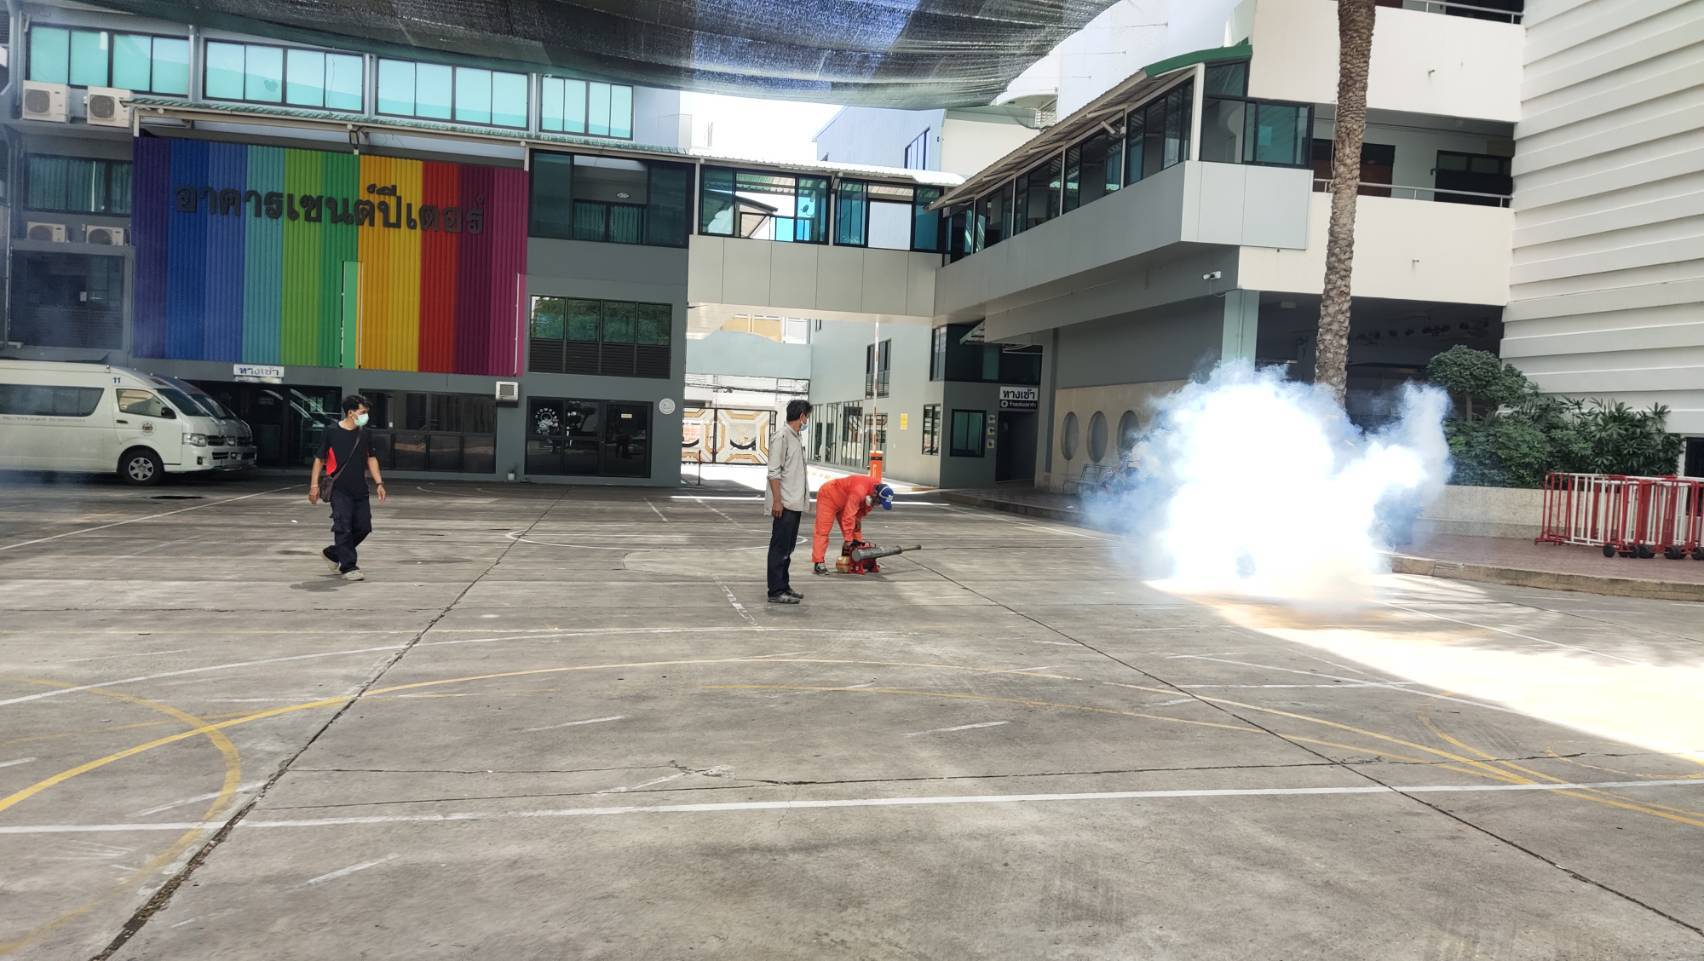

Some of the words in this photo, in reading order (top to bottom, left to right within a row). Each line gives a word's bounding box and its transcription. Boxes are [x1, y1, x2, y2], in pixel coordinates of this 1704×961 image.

[175, 183, 485, 234] อาคารเซนต์ปีเตอร์
[112, 376, 121, 384] 11
[1002, 389, 1035, 399] ทางเข้า
